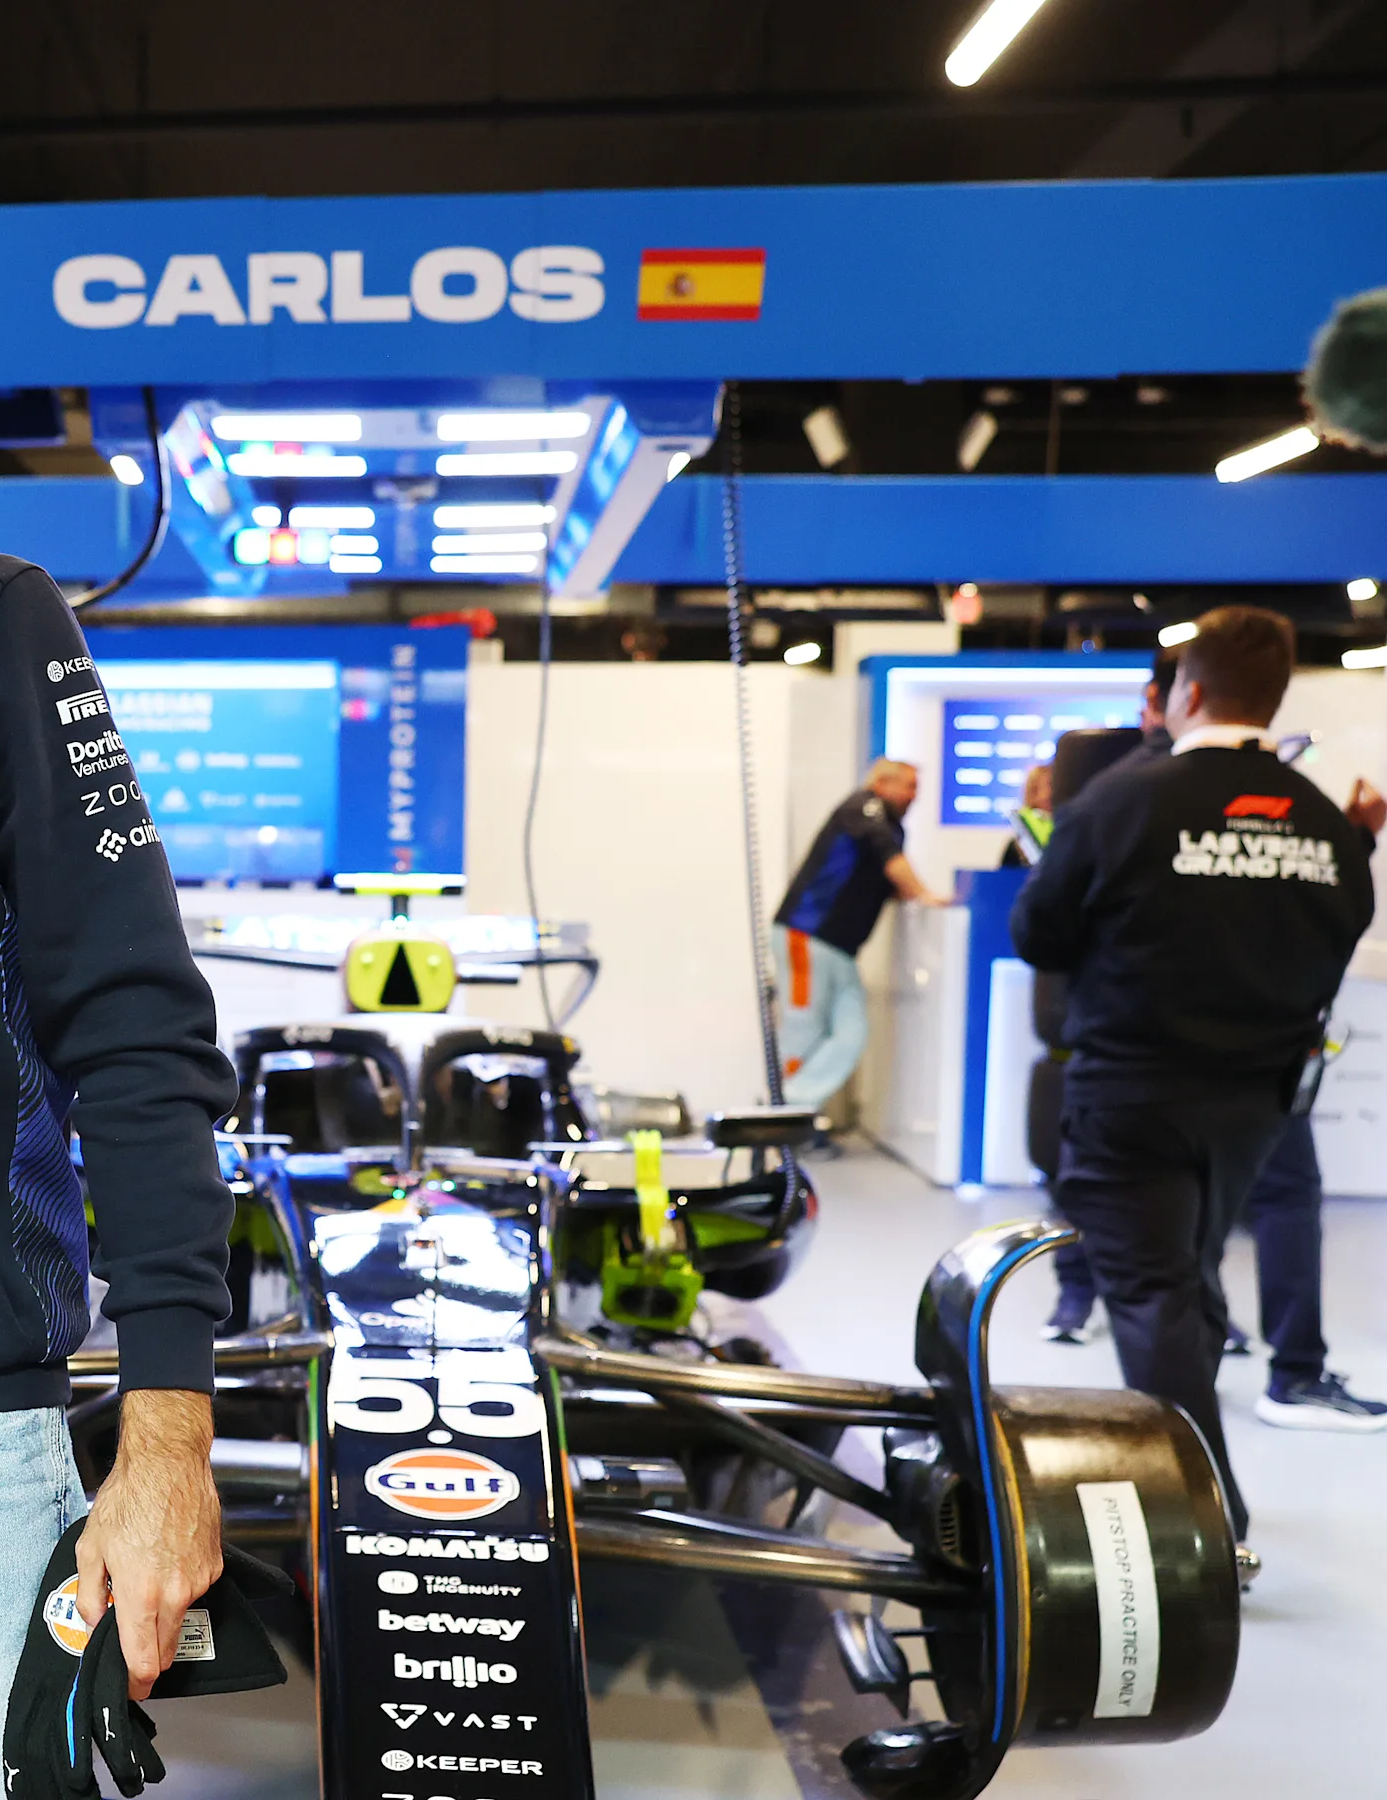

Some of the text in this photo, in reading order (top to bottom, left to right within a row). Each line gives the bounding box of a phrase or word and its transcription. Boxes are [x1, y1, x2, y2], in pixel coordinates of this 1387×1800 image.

[53, 245, 605, 328] CARLOS
[388, 644, 416, 841] MYPROTEIN
[72, 753, 129, 778] Ventures
[1179, 829, 1334, 863] LAS VEGAS
[1172, 853, 1338, 886] GRAND PRIX
[330, 1353, 543, 1438] 55
[378, 1473, 504, 1492] Gulf
[346, 1535, 549, 1562] KOMATSU
[423, 1575, 462, 1585] THG
[426, 1584, 522, 1596] INGENUITY
[378, 1609, 526, 1641] betway
[1119, 1577, 1138, 1665] PRACTICE
[394, 1653, 517, 1688] brillio
[1117, 1670, 1136, 1707] ONLY
[433, 1711, 538, 1731] VAST
[417, 1755, 544, 1775] KEEPER
